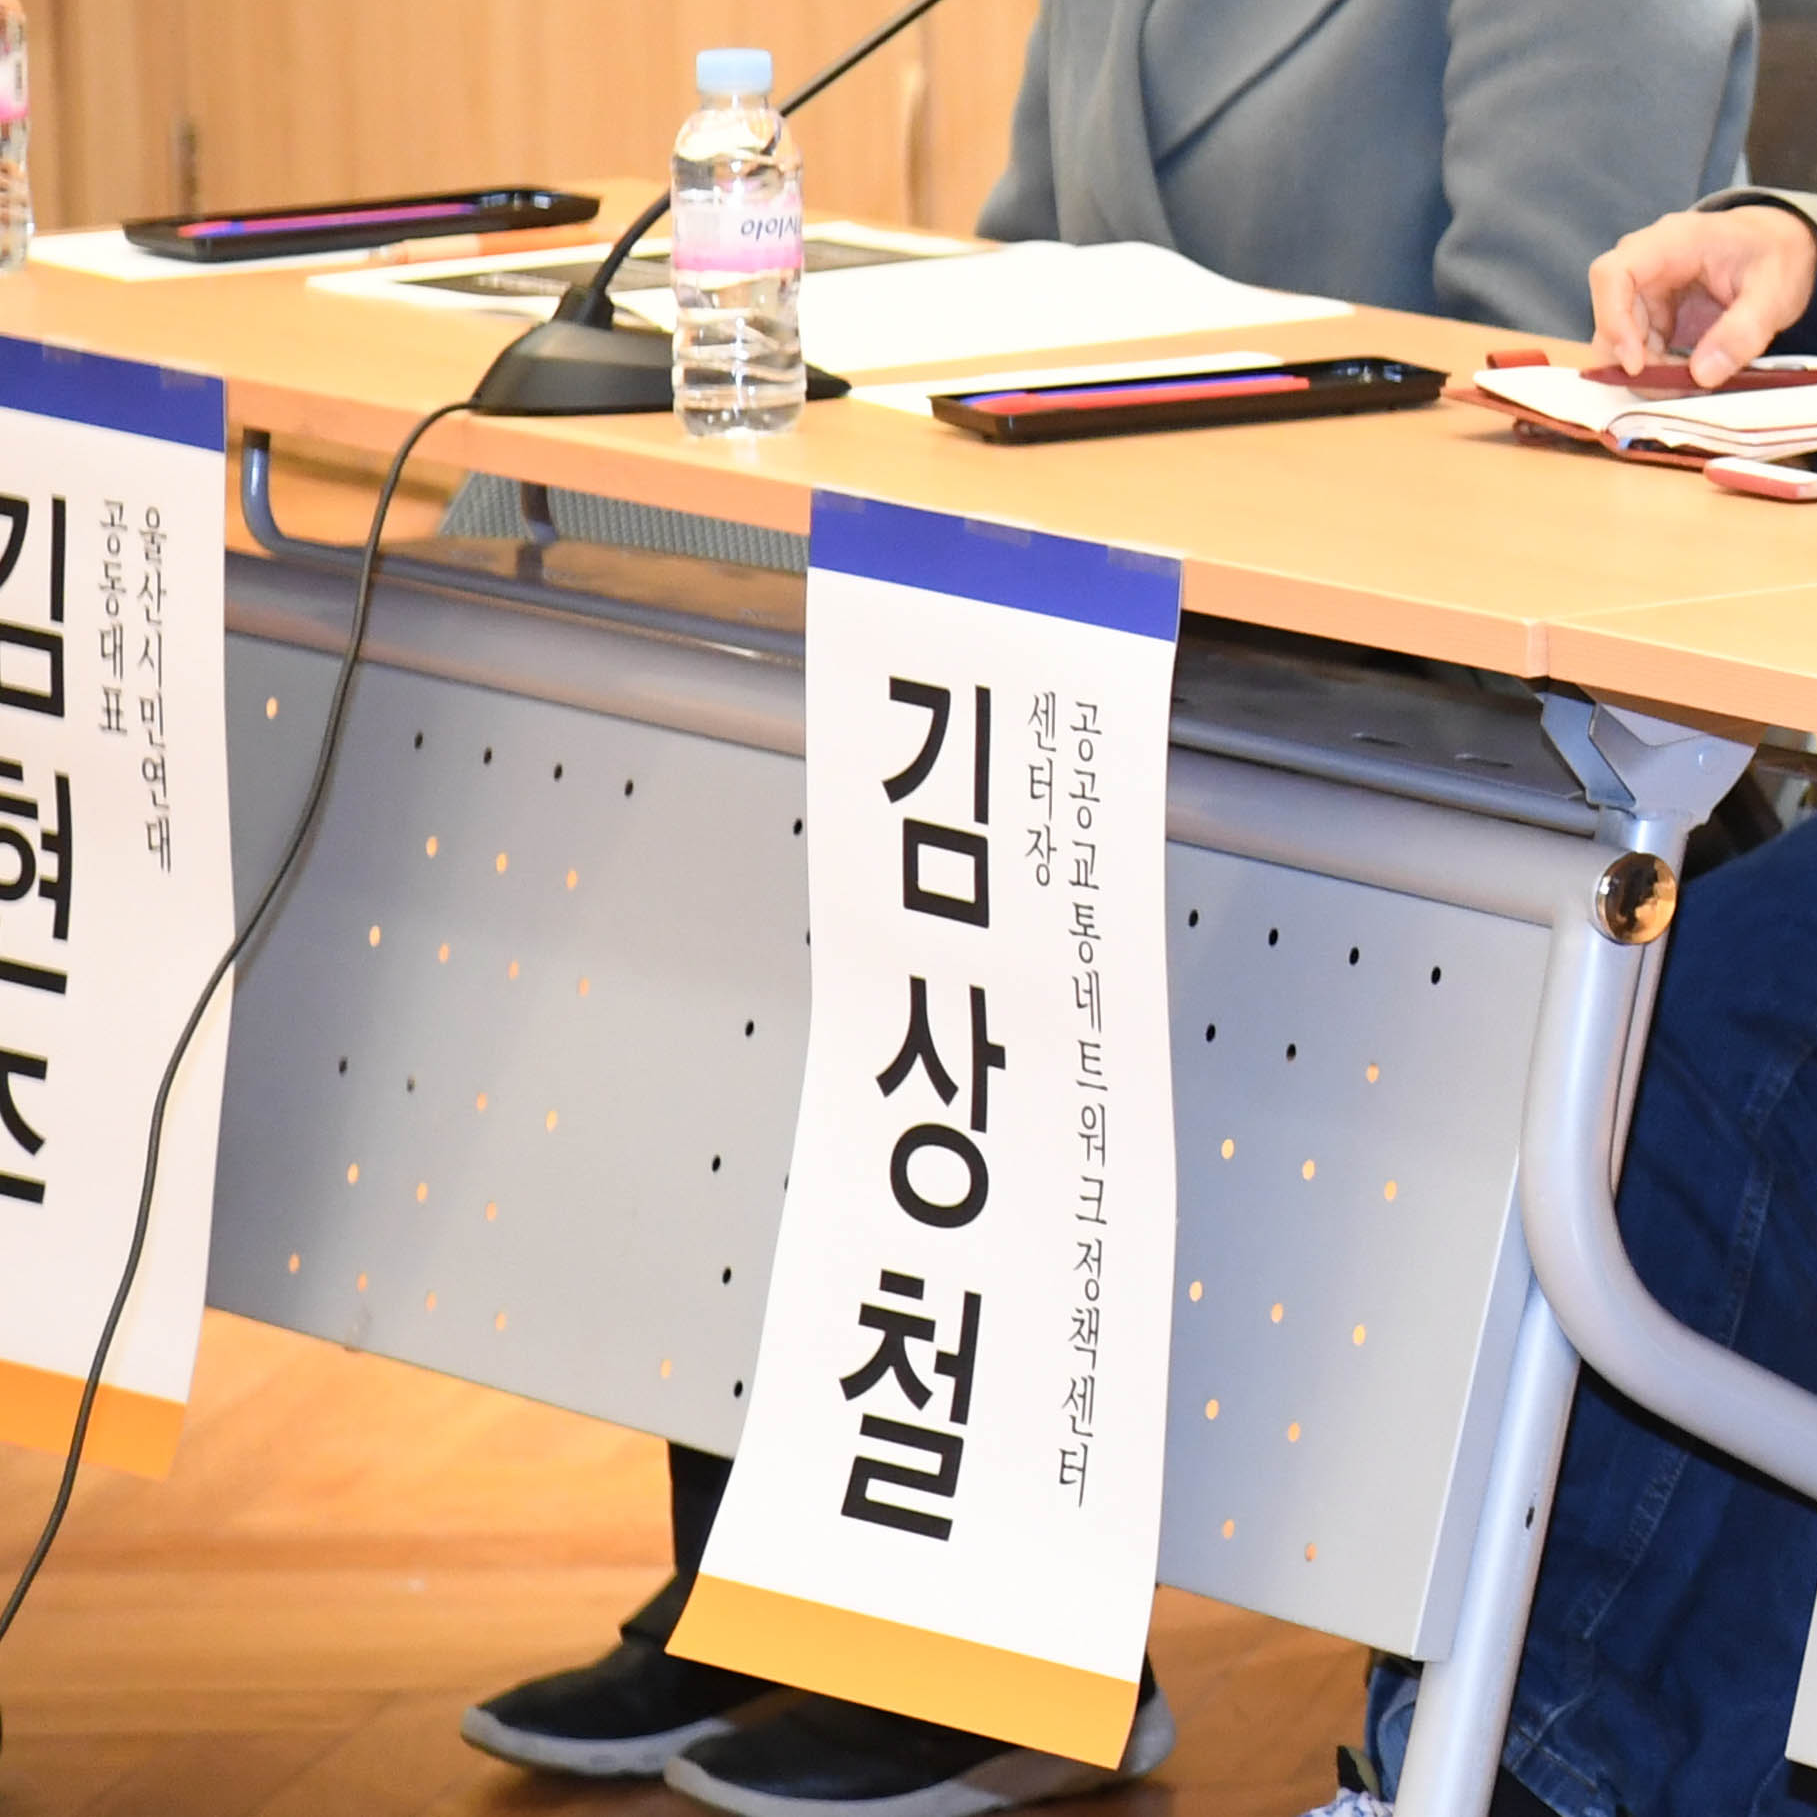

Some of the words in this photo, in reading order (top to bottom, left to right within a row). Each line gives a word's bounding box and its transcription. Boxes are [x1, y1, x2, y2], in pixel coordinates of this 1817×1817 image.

[97, 500, 130, 735] 공동대표
[135, 508, 172, 873] 울산시민연대
[1022, 690, 1058, 887] 센터장
[838, 676, 1006, 1542] 김상철
[1057, 700, 1108, 1508] 공공교통네트워크정책센터
